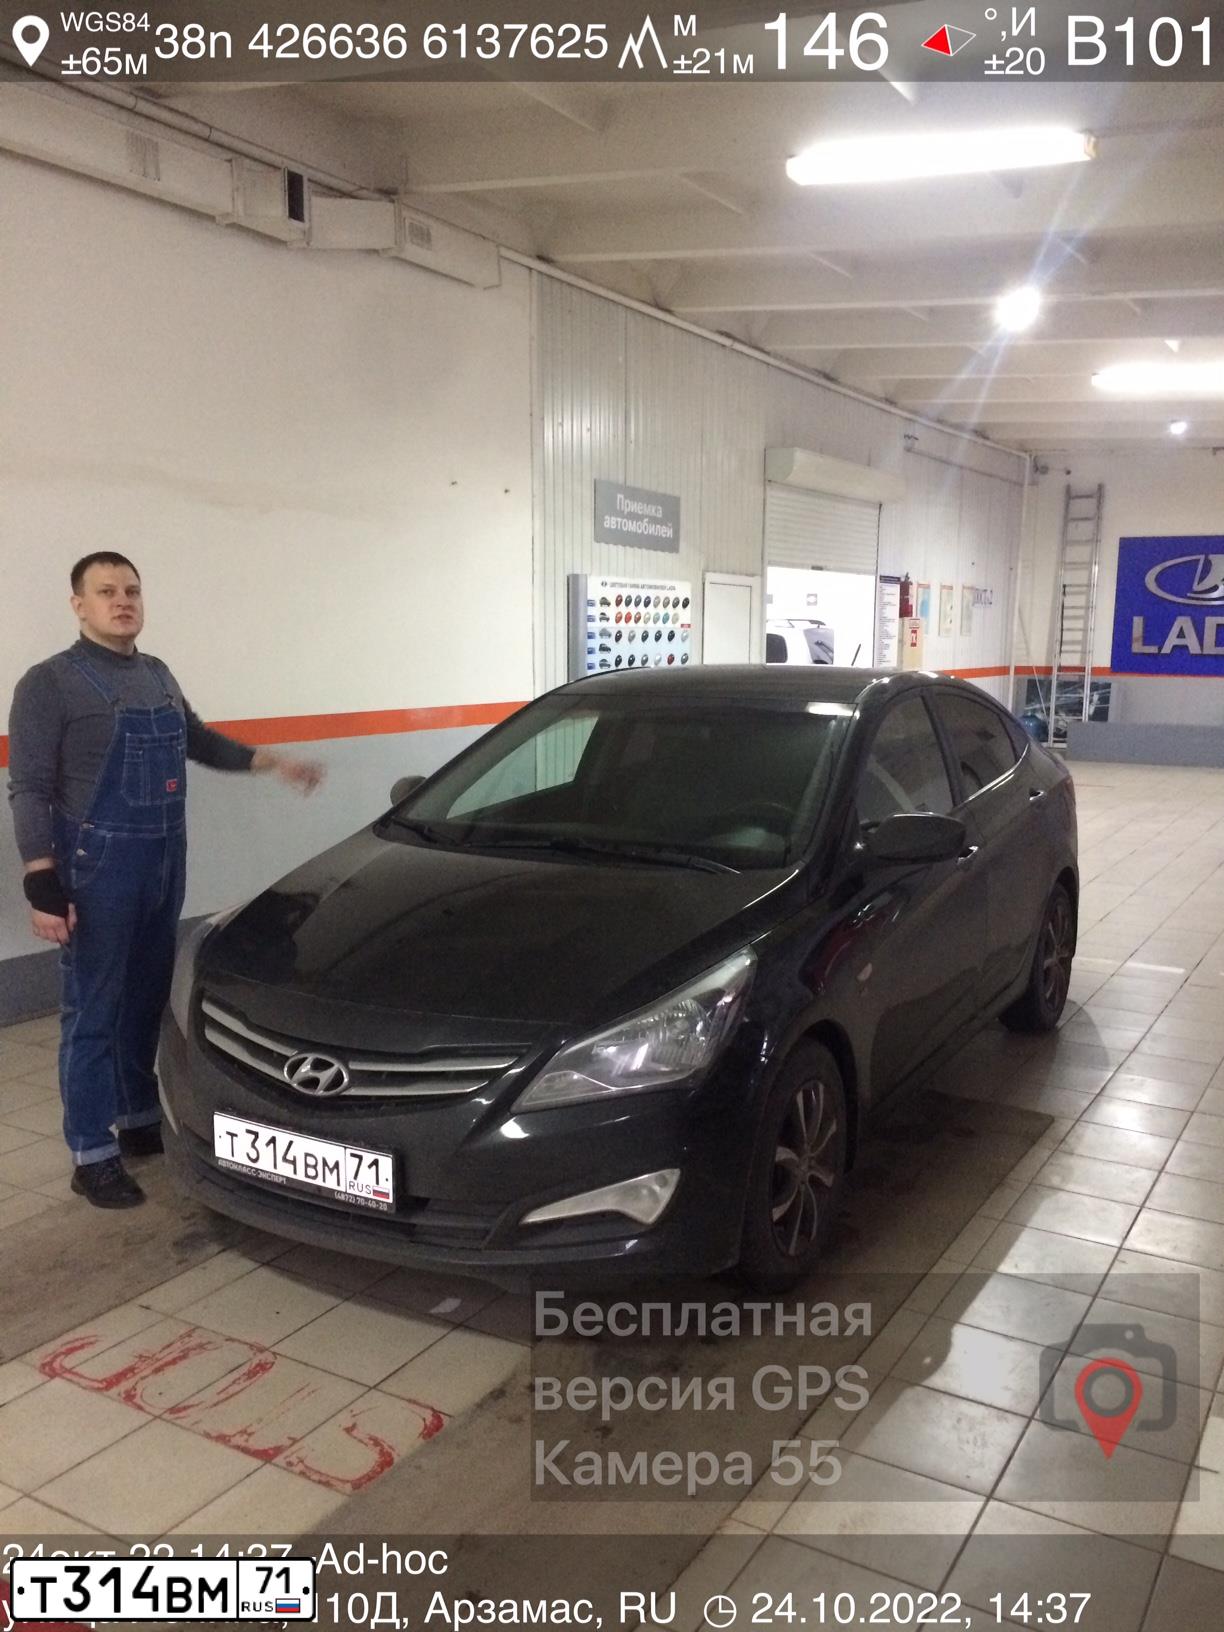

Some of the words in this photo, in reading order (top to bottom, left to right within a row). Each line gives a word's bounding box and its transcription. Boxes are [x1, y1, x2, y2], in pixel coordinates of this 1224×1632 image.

[616, 494, 662, 518] Приемка
[603, 515, 673, 538] автомобилей
[349, 1153, 380, 1186] 71
[348, 1181, 372, 1195] RUS
